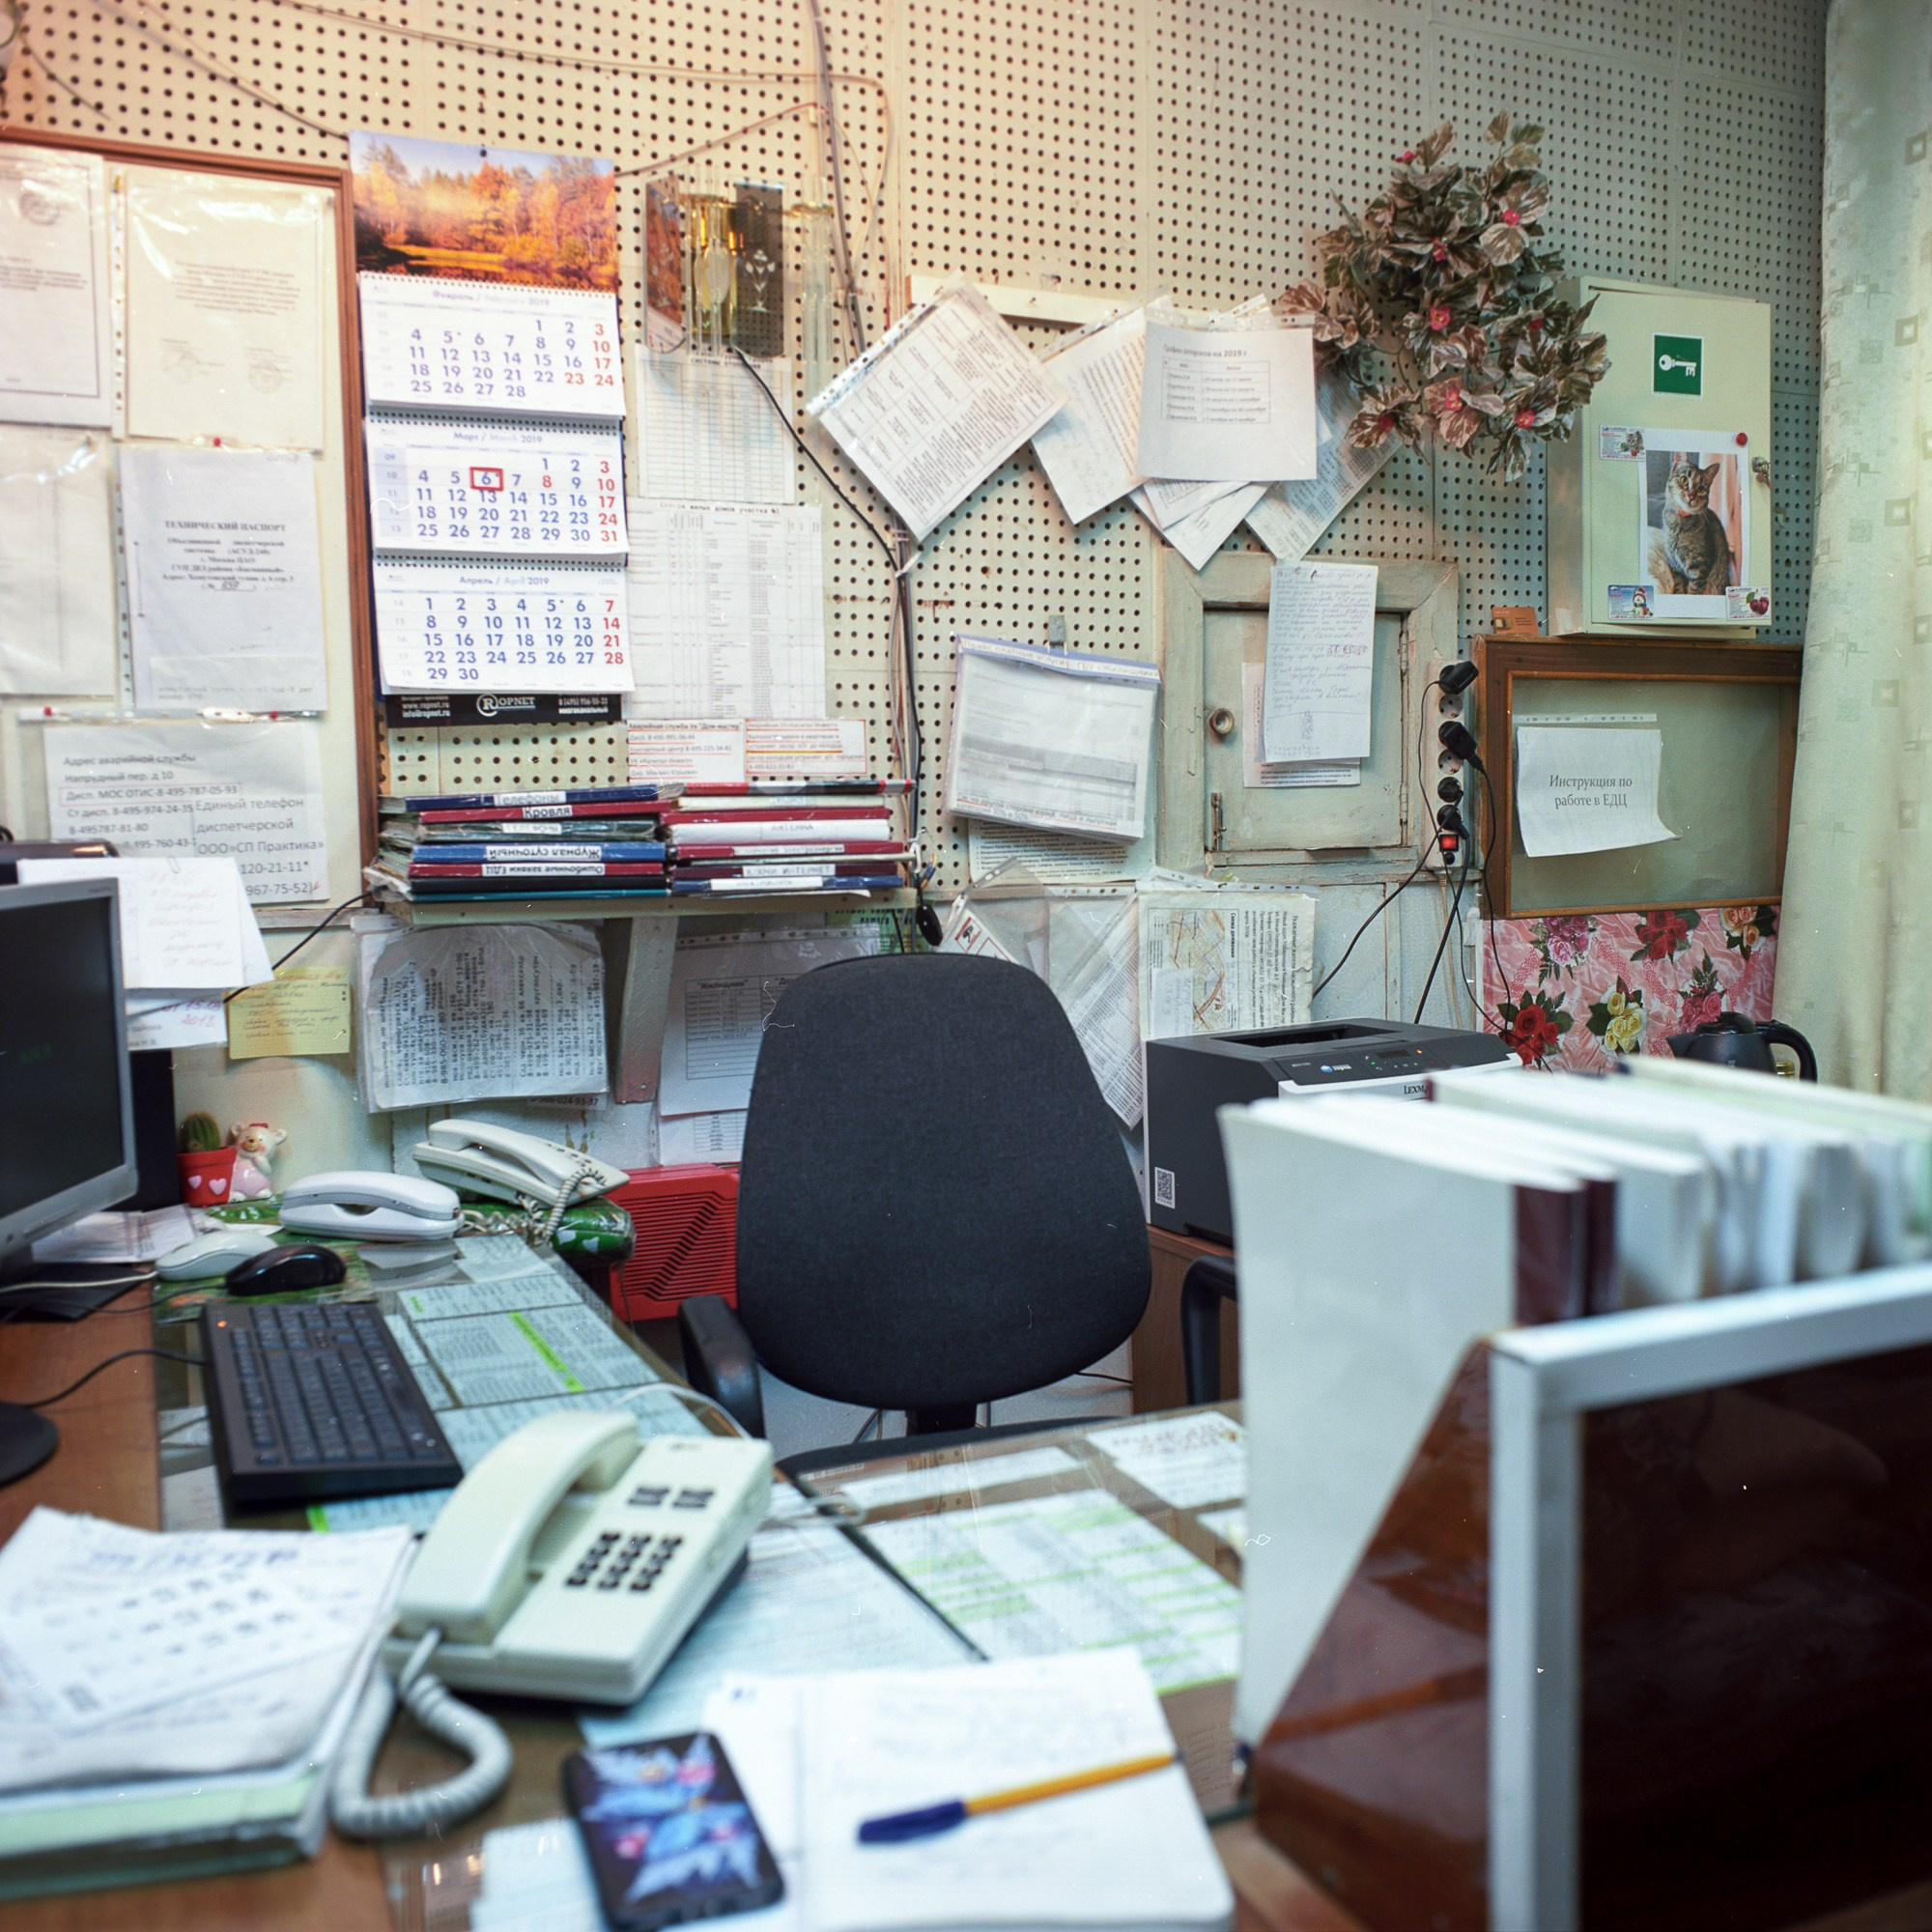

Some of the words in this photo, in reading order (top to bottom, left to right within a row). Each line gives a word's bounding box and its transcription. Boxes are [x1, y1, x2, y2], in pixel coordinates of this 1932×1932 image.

[528, 297, 550, 306] 2019
[536, 320, 541, 331] 1
[565, 322, 574, 333] 2
[595, 324, 604, 335] 3
[412, 329, 421, 340] 4
[444, 330, 453, 343] 5
[475, 333, 484, 345] 6
[506, 335, 514, 347] 7
[536, 337, 546, 349] 8
[566, 339, 576, 351] 9
[593, 340, 611, 353] 10
[410, 346, 424, 358] 11
[441, 348, 458, 360] 12
[472, 350, 490, 362] 13
[503, 352, 521, 363] 14
[534, 354, 552, 366] 15
[565, 355, 582, 368] 16
[595, 357, 611, 369] 17
[1224, 349, 1242, 357] 2019
[412, 363, 430, 376] 18
[443, 365, 461, 377] 19
[473, 367, 493, 379] 20
[504, 369, 521, 381] 21
[534, 371, 554, 383] 22
[565, 372, 584, 384] 23
[595, 375, 613, 386] 24
[411, 381, 432, 392] 25
[443, 382, 464, 394] 26
[475, 384, 494, 394] 27
[505, 385, 526, 397] 28
[453, 432, 479, 443] Март
[521, 435, 543, 443] 2019
[543, 458, 548, 469] 1
[571, 460, 580, 471] 2
[601, 461, 610, 473] 3
[419, 470, 428, 482] 4
[451, 471, 460, 484] 5
[481, 472, 492, 485] 6
[512, 474, 521, 486] 7
[543, 475, 552, 488] 8
[572, 477, 581, 489] 9
[598, 478, 614, 491] 10
[417, 488, 432, 500] 11
[448, 489, 466, 501] 12
[478, 491, 497, 503] 13
[510, 492, 527, 504] 14
[540, 493, 556, 505] 15
[570, 495, 586, 507] 16
[599, 496, 615, 508] 17
[418, 506, 437, 519] 18
[450, 507, 468, 519] 19
[479, 508, 498, 521] 20
[510, 509, 526, 522] 21
[540, 510, 558, 523] 22
[569, 512, 588, 525] 23
[599, 513, 617, 526] 24
[417, 524, 438, 536] 25
[449, 525, 469, 537] 26
[480, 526, 499, 538] 27
[511, 526, 530, 539] 28
[541, 527, 560, 540] 29
[571, 529, 590, 541] 30
[601, 530, 616, 541] 31
[459, 576, 493, 586] Апрель
[527, 577, 550, 585] 2019
[427, 598, 432, 610] 1
[456, 598, 466, 611] 2
[487, 598, 497, 611] 3
[517, 599, 526, 611] 4
[548, 599, 555, 611] 5
[577, 600, 585, 611] 6
[606, 600, 613, 611] 7
[427, 615, 436, 628] 8
[458, 615, 467, 628] 9
[485, 616, 502, 629] 10
[516, 616, 529, 629] 11
[545, 617, 561, 629] 12
[574, 617, 591, 630] 13
[604, 617, 620, 629] 14
[425, 634, 442, 646] 15
[456, 634, 473, 646] 16
[487, 634, 503, 646] 17
[517, 634, 534, 646] 18
[547, 635, 563, 646] 19
[574, 635, 593, 647] 20
[604, 635, 619, 647] 21
[425, 651, 445, 663] 22
[456, 651, 476, 663] 23
[487, 651, 506, 663] 24
[517, 651, 536, 664] 25
[547, 652, 566, 664] 26
[576, 652, 594, 664] 27
[605, 652, 623, 664] 28
[428, 668, 447, 679] 29
[459, 668, 478, 679] 30
[63, 756, 96, 767] Адрес
[98, 754, 154, 765] аварийной
[156, 753, 196, 764] службы
[161, 771, 174, 780] 10
[1549, 775, 1616, 791] Инструкция
[1619, 779, 1633, 787] по
[99, 789, 124, 799] МОС
[195, 798, 246, 812] Единый
[249, 797, 304, 810] телефон
[1554, 793, 1592, 810] работе
[1594, 797, 1601, 806] в
[1603, 793, 1628, 809] ЕДЦ
[525, 806, 571, 818] Кровля
[196, 818, 294, 834] диспетчерской
[489, 847, 549, 860] суточный
[552, 847, 600, 860] Журнал
[486, 864, 506, 875] ЕДЦ
[545, 866, 603, 874] Ошибочные
